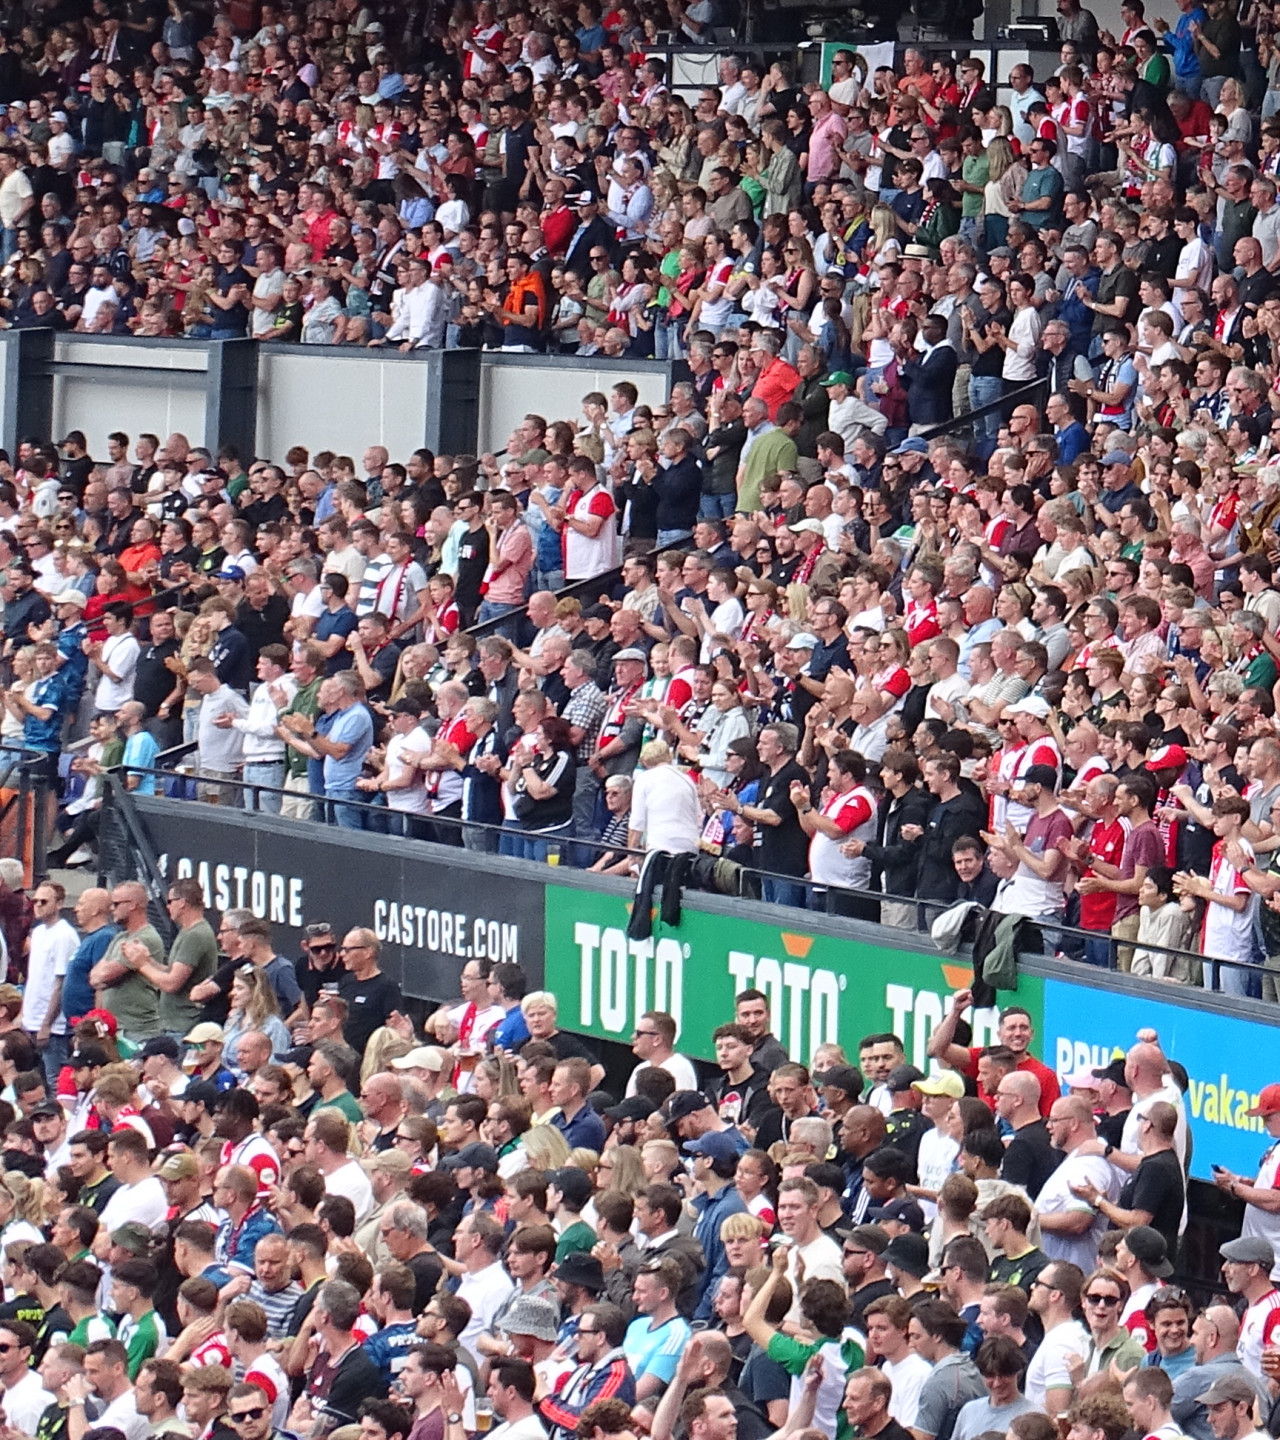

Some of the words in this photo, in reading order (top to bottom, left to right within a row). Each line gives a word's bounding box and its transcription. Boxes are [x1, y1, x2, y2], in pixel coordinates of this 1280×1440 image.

[373, 899, 519, 964] CASTORE.COM
[574, 921, 684, 1044] TOTO
[886, 983, 1006, 1080] TOO
